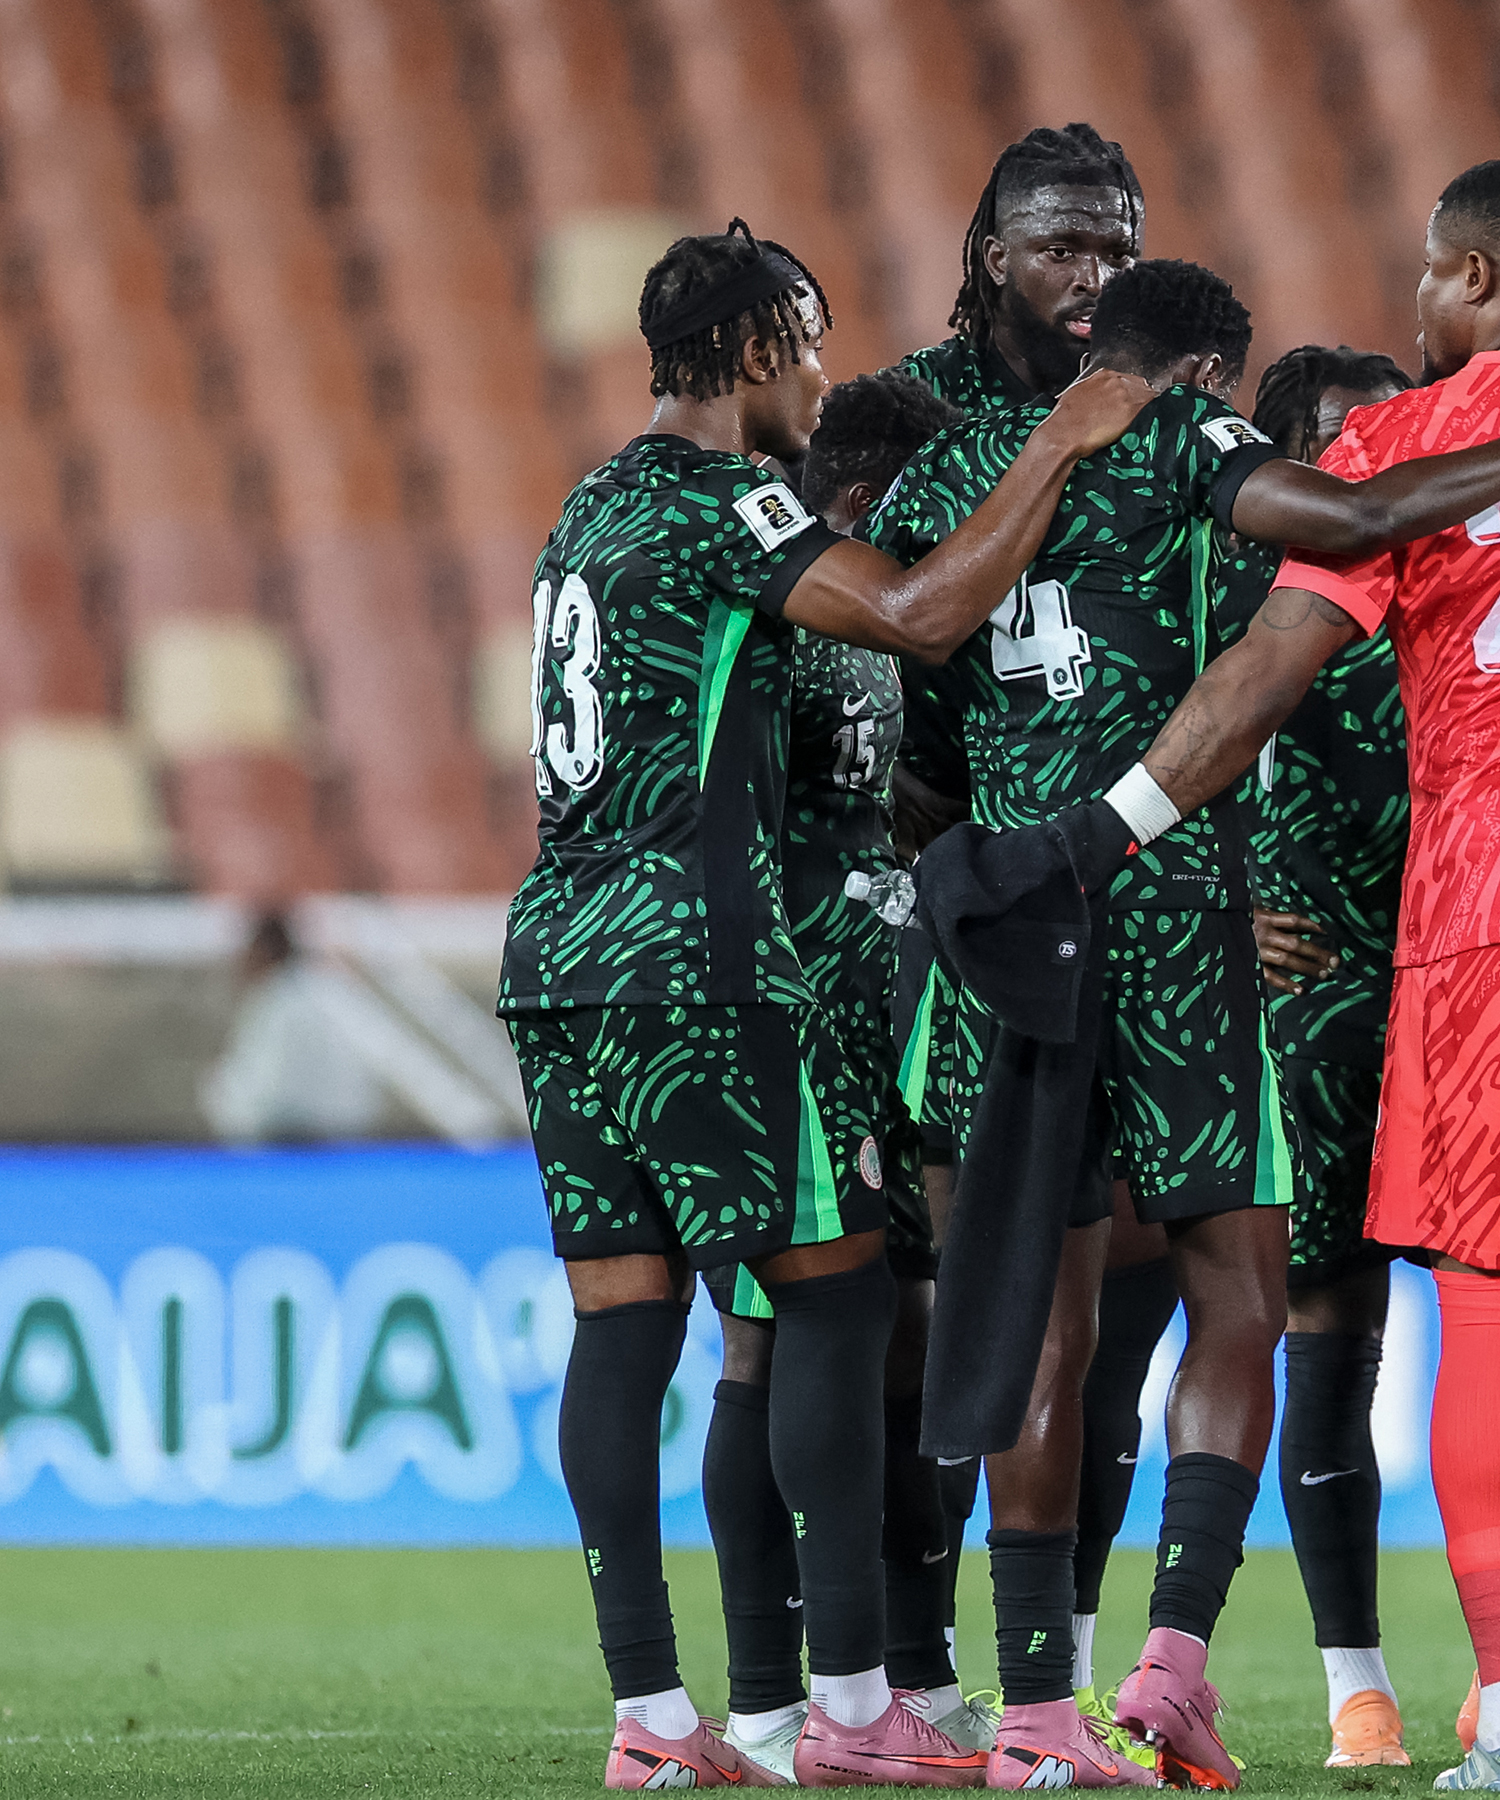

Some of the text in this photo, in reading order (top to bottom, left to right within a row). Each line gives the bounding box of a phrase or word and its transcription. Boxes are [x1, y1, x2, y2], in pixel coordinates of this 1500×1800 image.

[988, 570, 1092, 702] 4
[529, 573, 604, 796] 13
[792, 1511, 807, 1540] NFF
[587, 1548, 604, 1577] NFF
[1165, 1543, 1183, 1569] NFF
[1026, 1630, 1048, 1655] NFF
